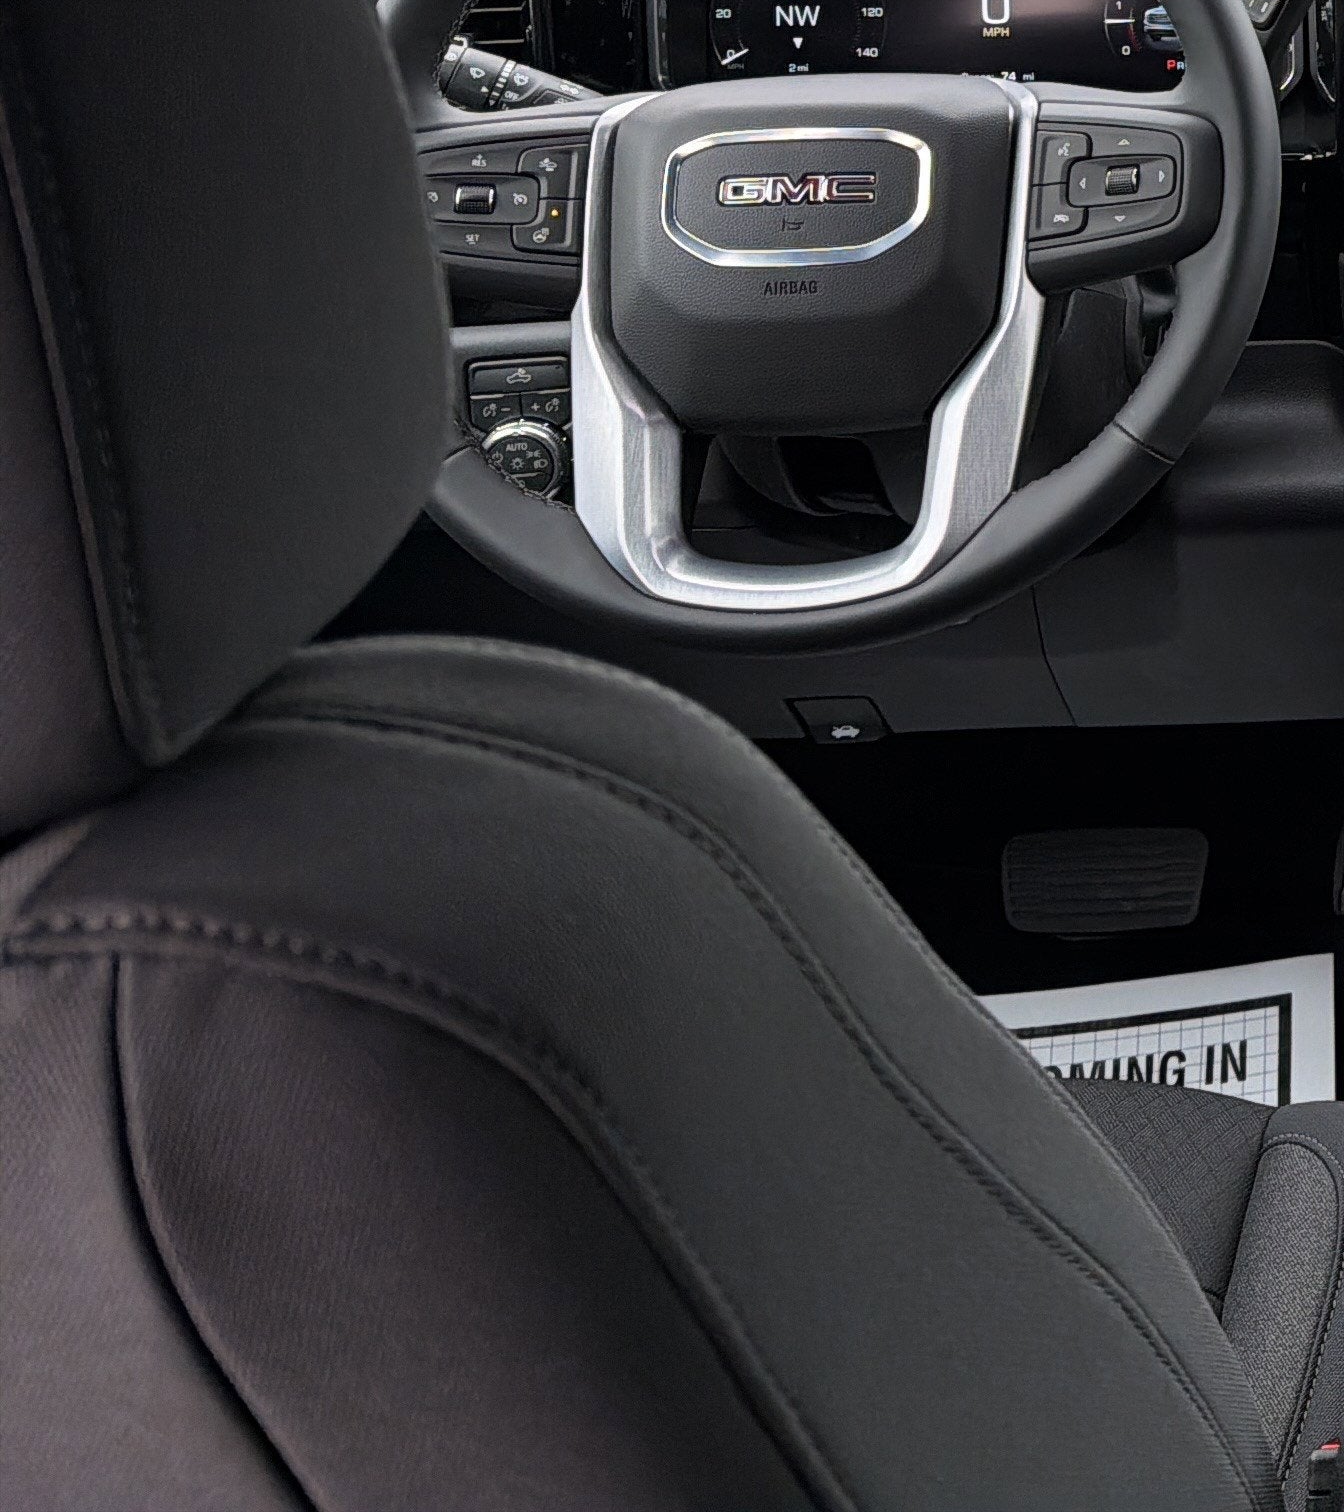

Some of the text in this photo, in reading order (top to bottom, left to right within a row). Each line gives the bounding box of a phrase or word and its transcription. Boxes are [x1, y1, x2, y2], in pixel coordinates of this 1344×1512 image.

[1115, 0, 1122, 10] 1
[715, 8, 732, 19] 20
[775, 4, 821, 27] NW
[861, 7, 884, 18] 120
[983, 27, 1010, 38] MPH
[855, 47, 879, 58] 140
[1121, 45, 1131, 56] 0
[788, 63, 809, 73] 2 mi
[1022, 71, 1035, 81] mi
[718, 175, 877, 206] GMC
[764, 280, 818, 296] AIRBAG
[506, 442, 528, 452] AUTO
[1205, 1039, 1248, 1086] IN
